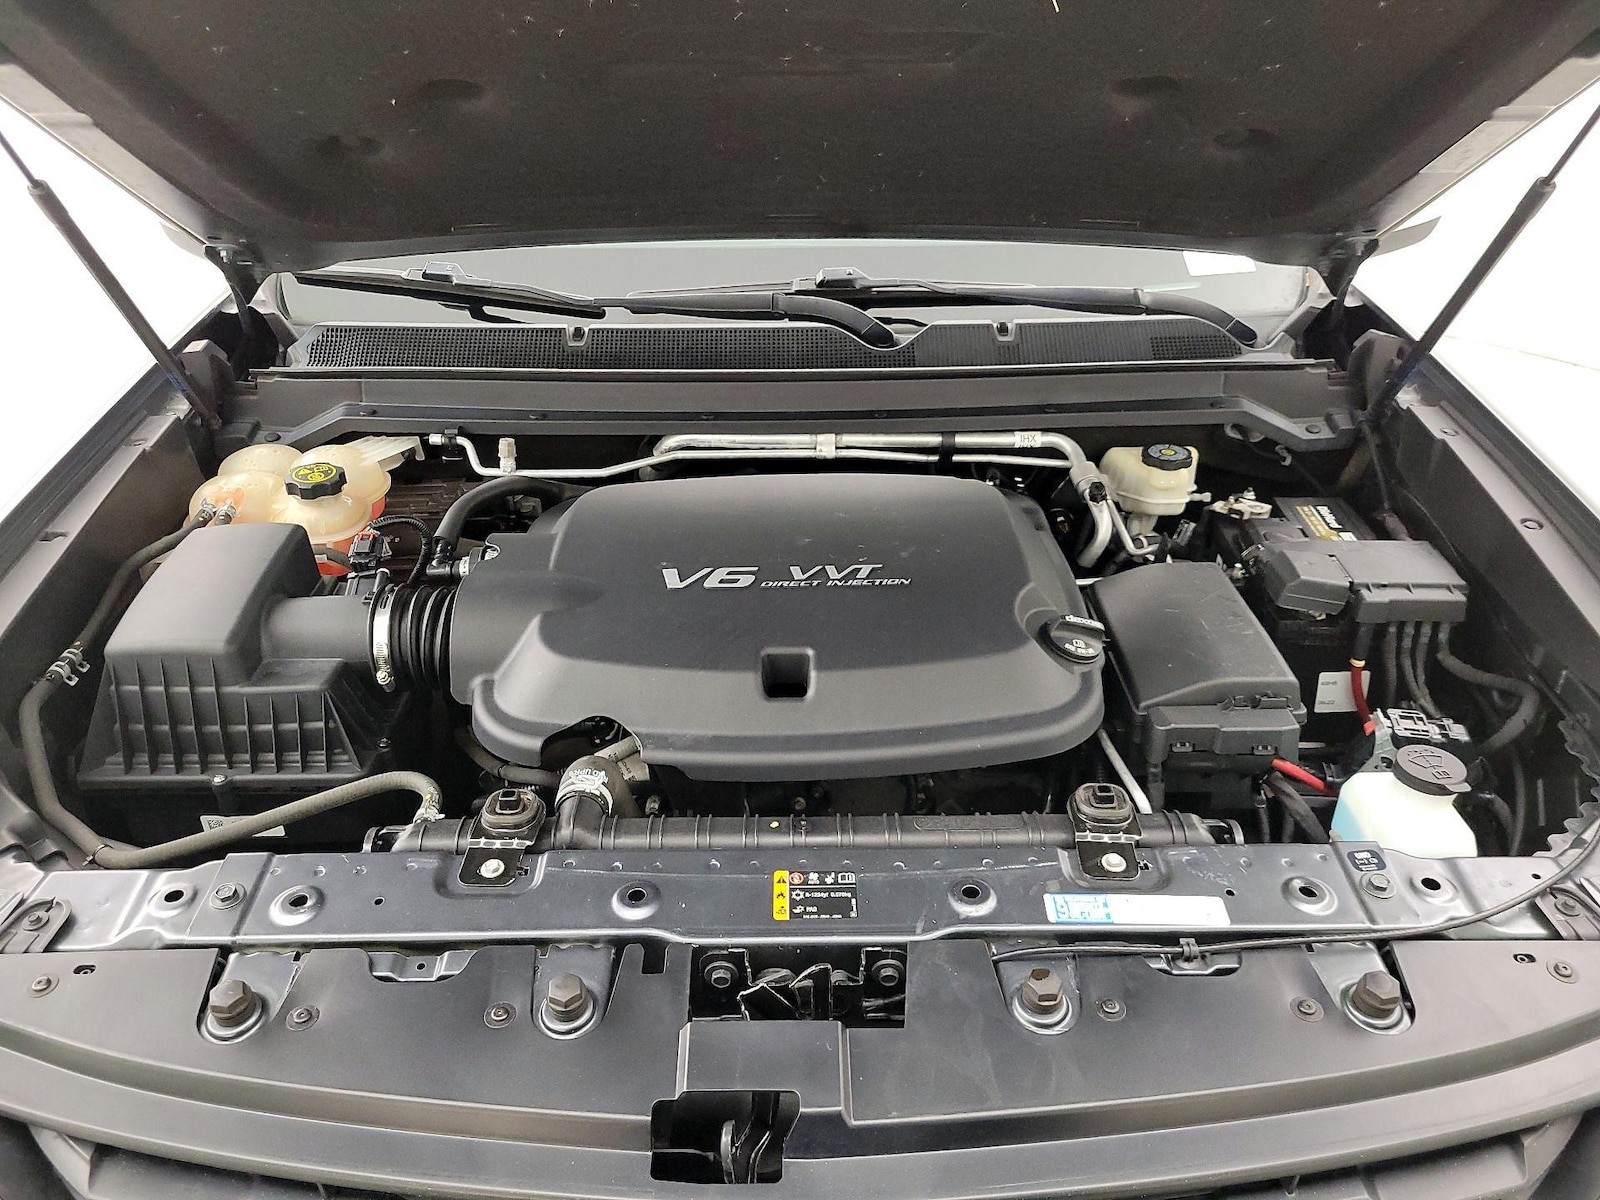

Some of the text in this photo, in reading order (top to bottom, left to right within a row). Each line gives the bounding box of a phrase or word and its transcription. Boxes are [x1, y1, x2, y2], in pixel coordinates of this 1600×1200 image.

[661, 564, 883, 589] V6 VVT
[760, 578, 912, 588] DIRECT INJECTION
